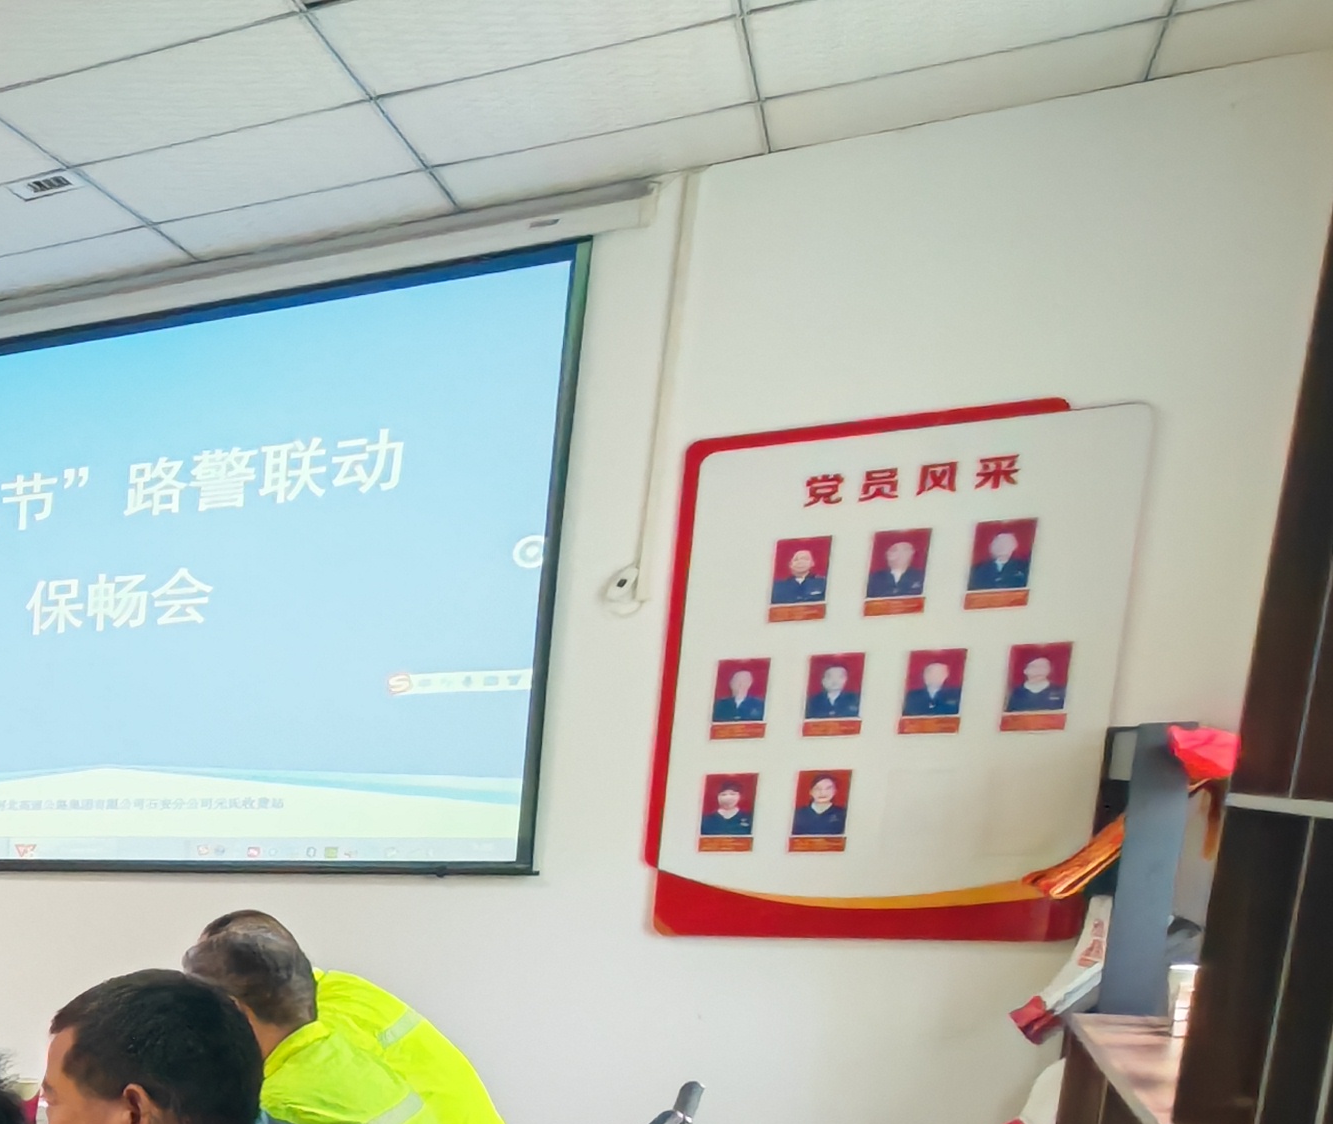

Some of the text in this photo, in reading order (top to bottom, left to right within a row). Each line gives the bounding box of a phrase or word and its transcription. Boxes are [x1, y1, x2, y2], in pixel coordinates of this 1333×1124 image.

[803, 453, 1022, 509] 党员风采
[25, 566, 215, 636] 保畅会
